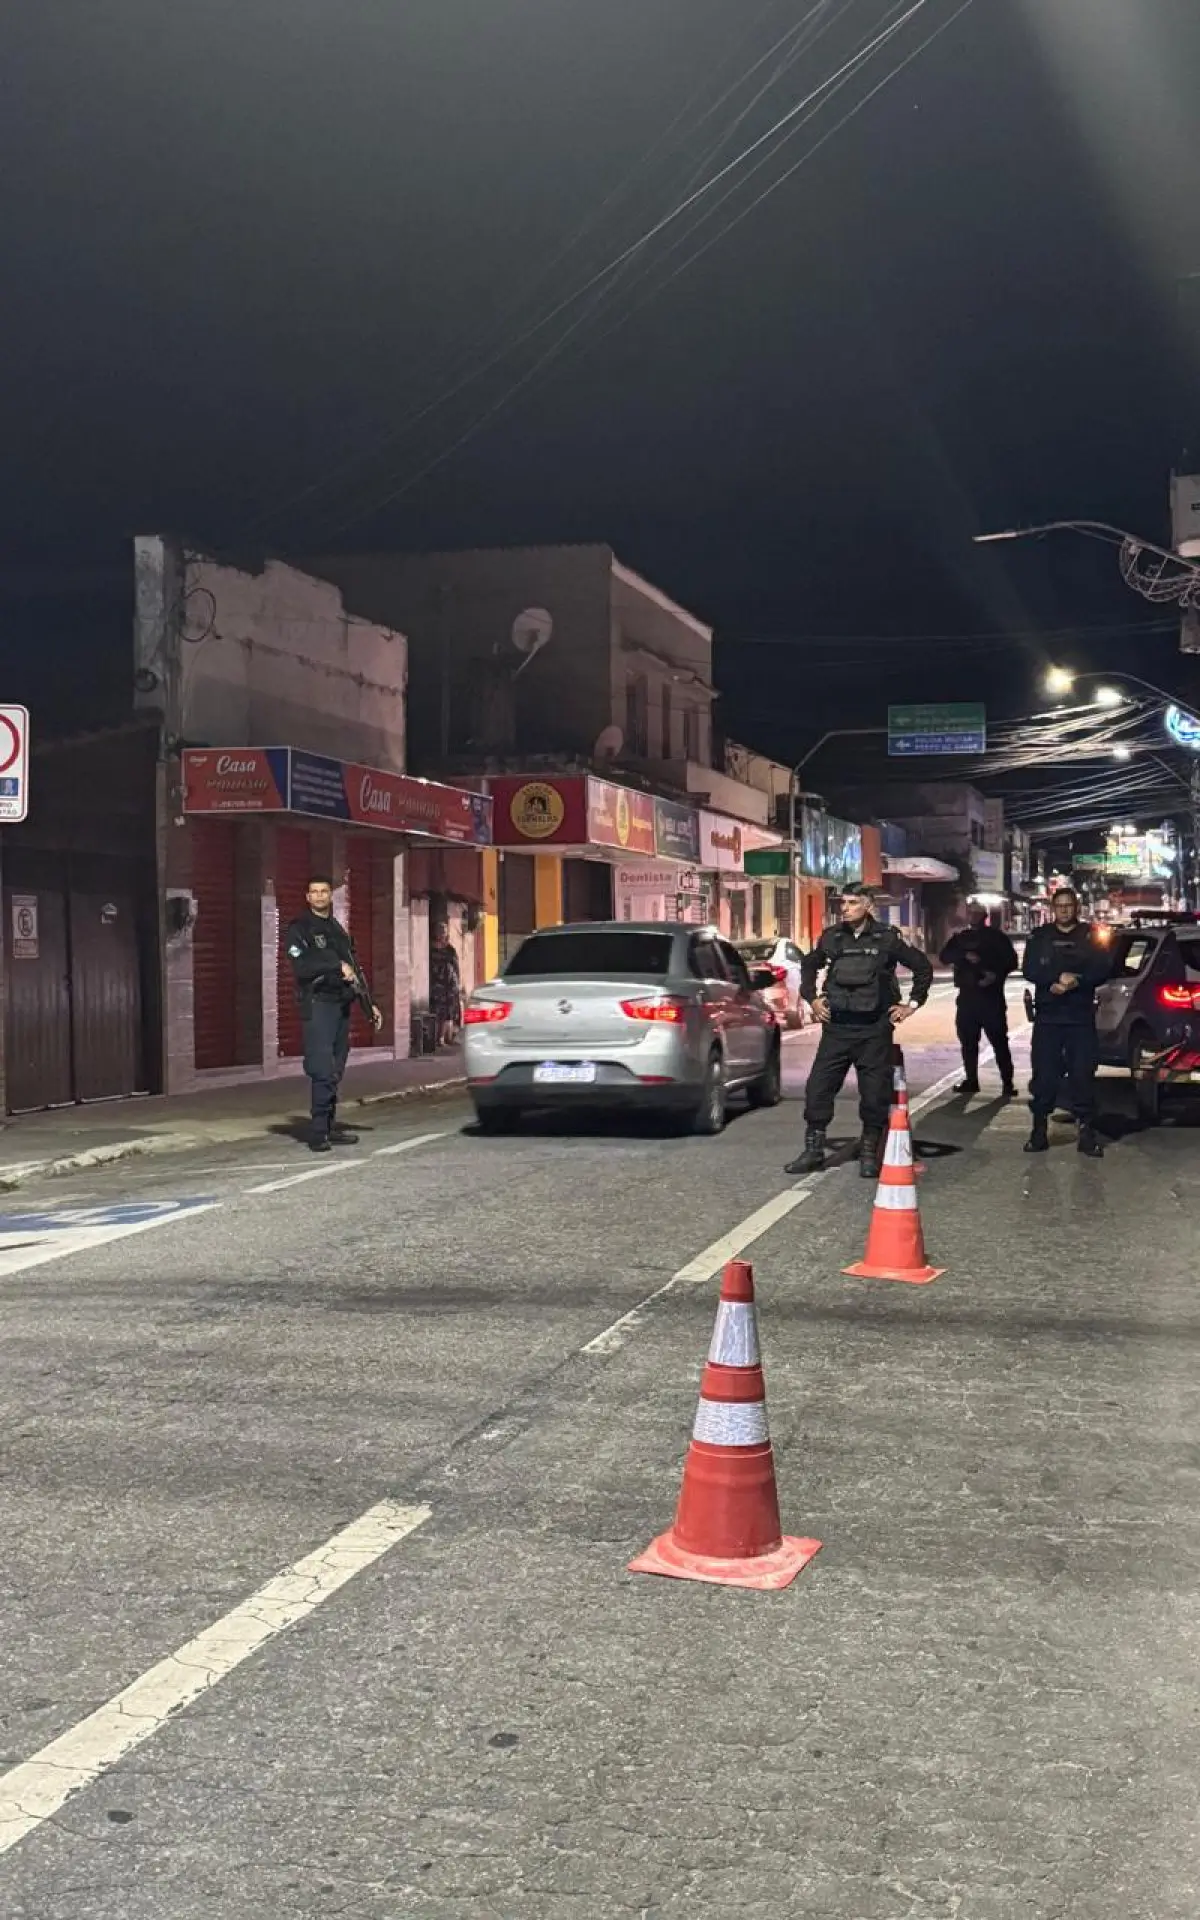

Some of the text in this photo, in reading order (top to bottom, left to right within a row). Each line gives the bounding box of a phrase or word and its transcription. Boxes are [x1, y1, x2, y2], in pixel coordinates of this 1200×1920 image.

[216, 755, 256, 775] Casa
[359, 773, 391, 813] Casa
[620, 871, 673, 883] Dentista
